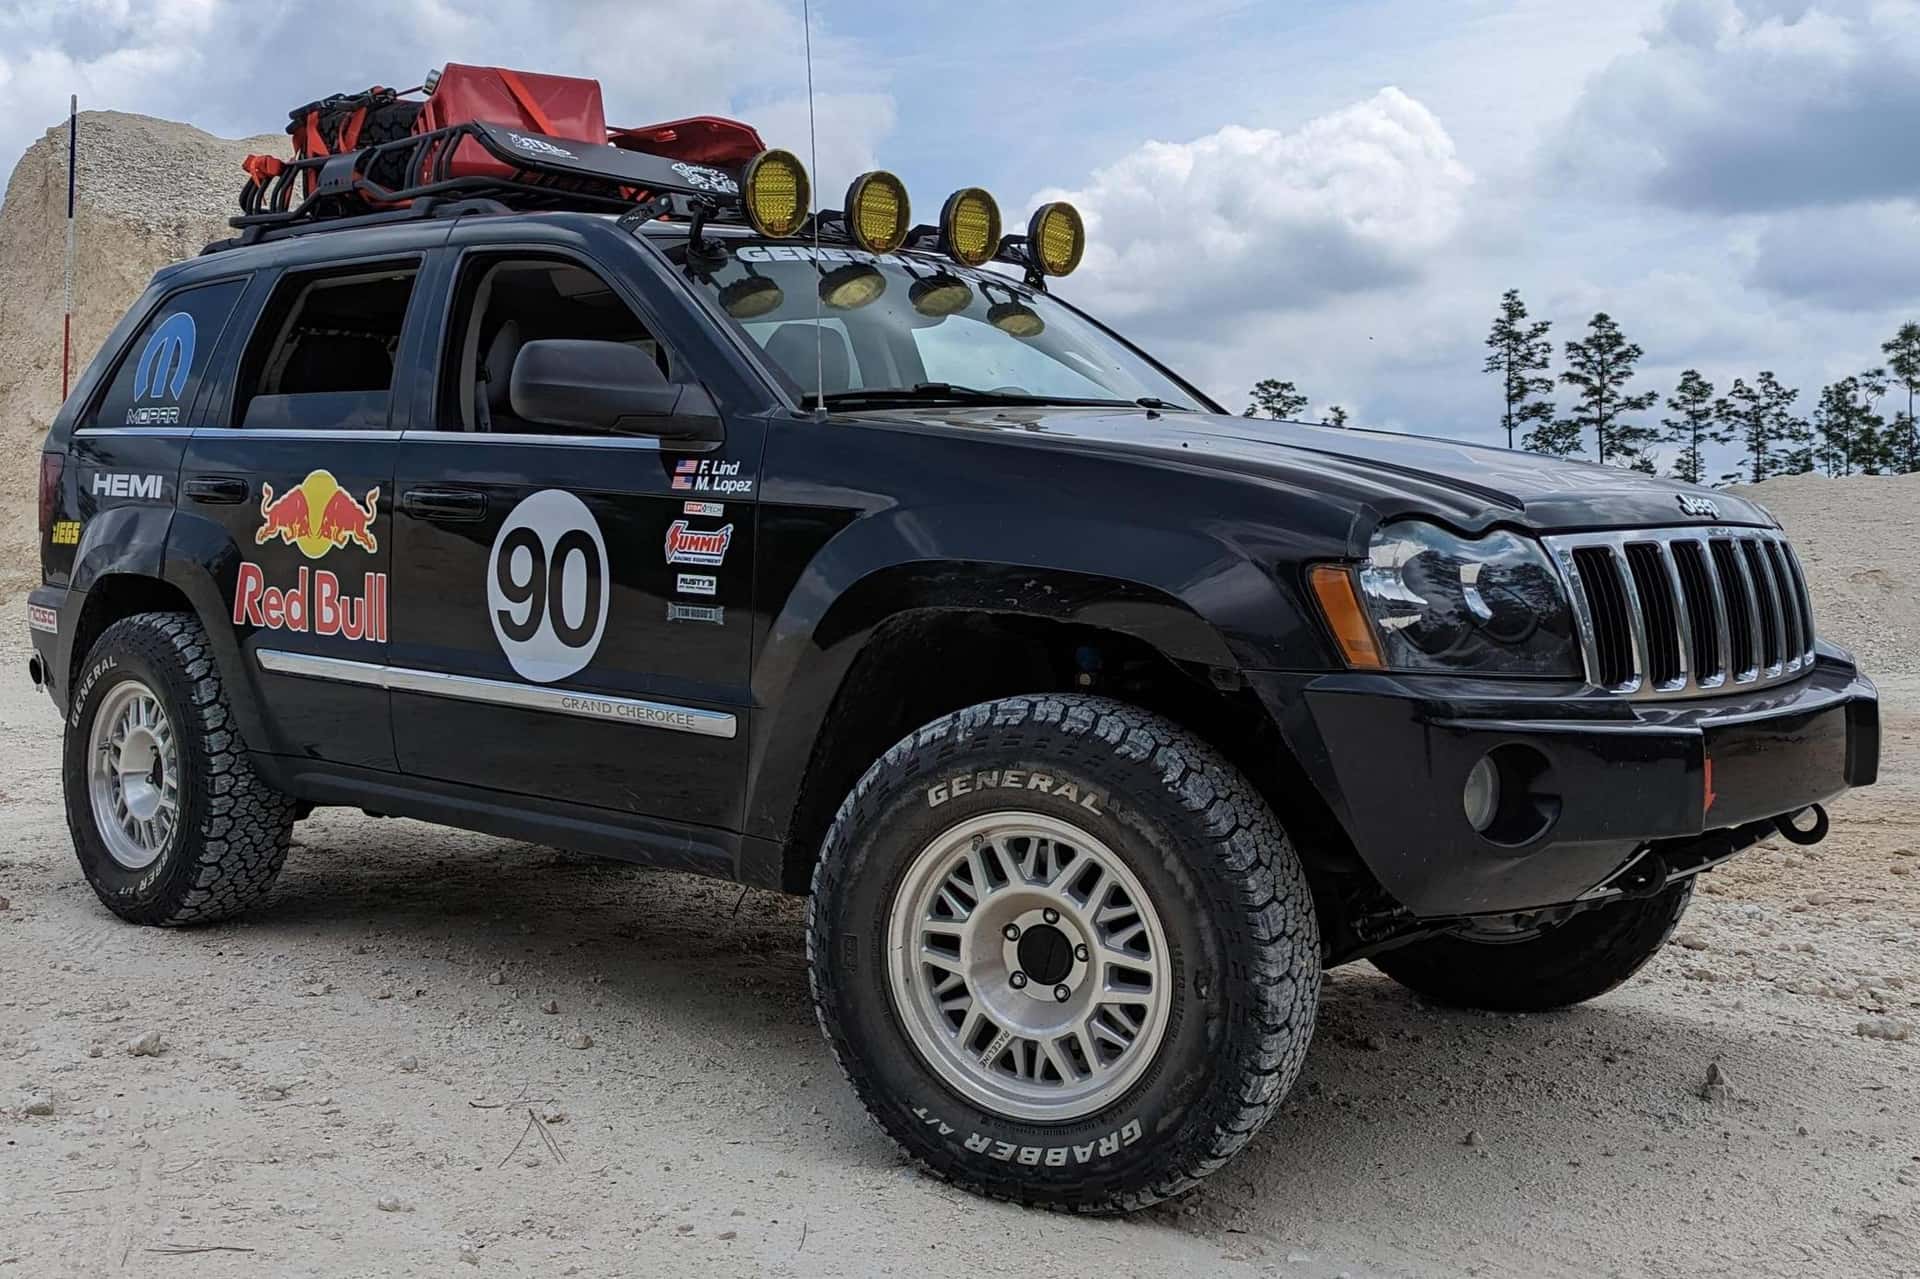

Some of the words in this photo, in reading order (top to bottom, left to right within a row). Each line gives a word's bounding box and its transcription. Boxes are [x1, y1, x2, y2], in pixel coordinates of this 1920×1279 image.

[126, 406, 180, 425] MOPAR
[698, 459, 711, 475] F.
[711, 459, 741, 476] Lind
[92, 472, 163, 499] HEMI
[694, 475, 711, 491] M.
[713, 476, 753, 495] Lopez
[1675, 492, 1721, 521] Jeep
[51, 521, 81, 545] JEGS
[667, 522, 729, 554] SUMMIT
[232, 561, 309, 633] Red
[314, 569, 388, 643] Bull
[496, 526, 602, 648] 90
[70, 654, 118, 729] GENERAL
[560, 696, 613, 715] GRAND
[616, 703, 696, 727] CHEROKEE
[927, 769, 1106, 817] GENERAL
[978, 1029, 1011, 1068] RACELINE
[912, 1105, 955, 1140] A/T
[962, 1117, 1144, 1168] GRABBER
